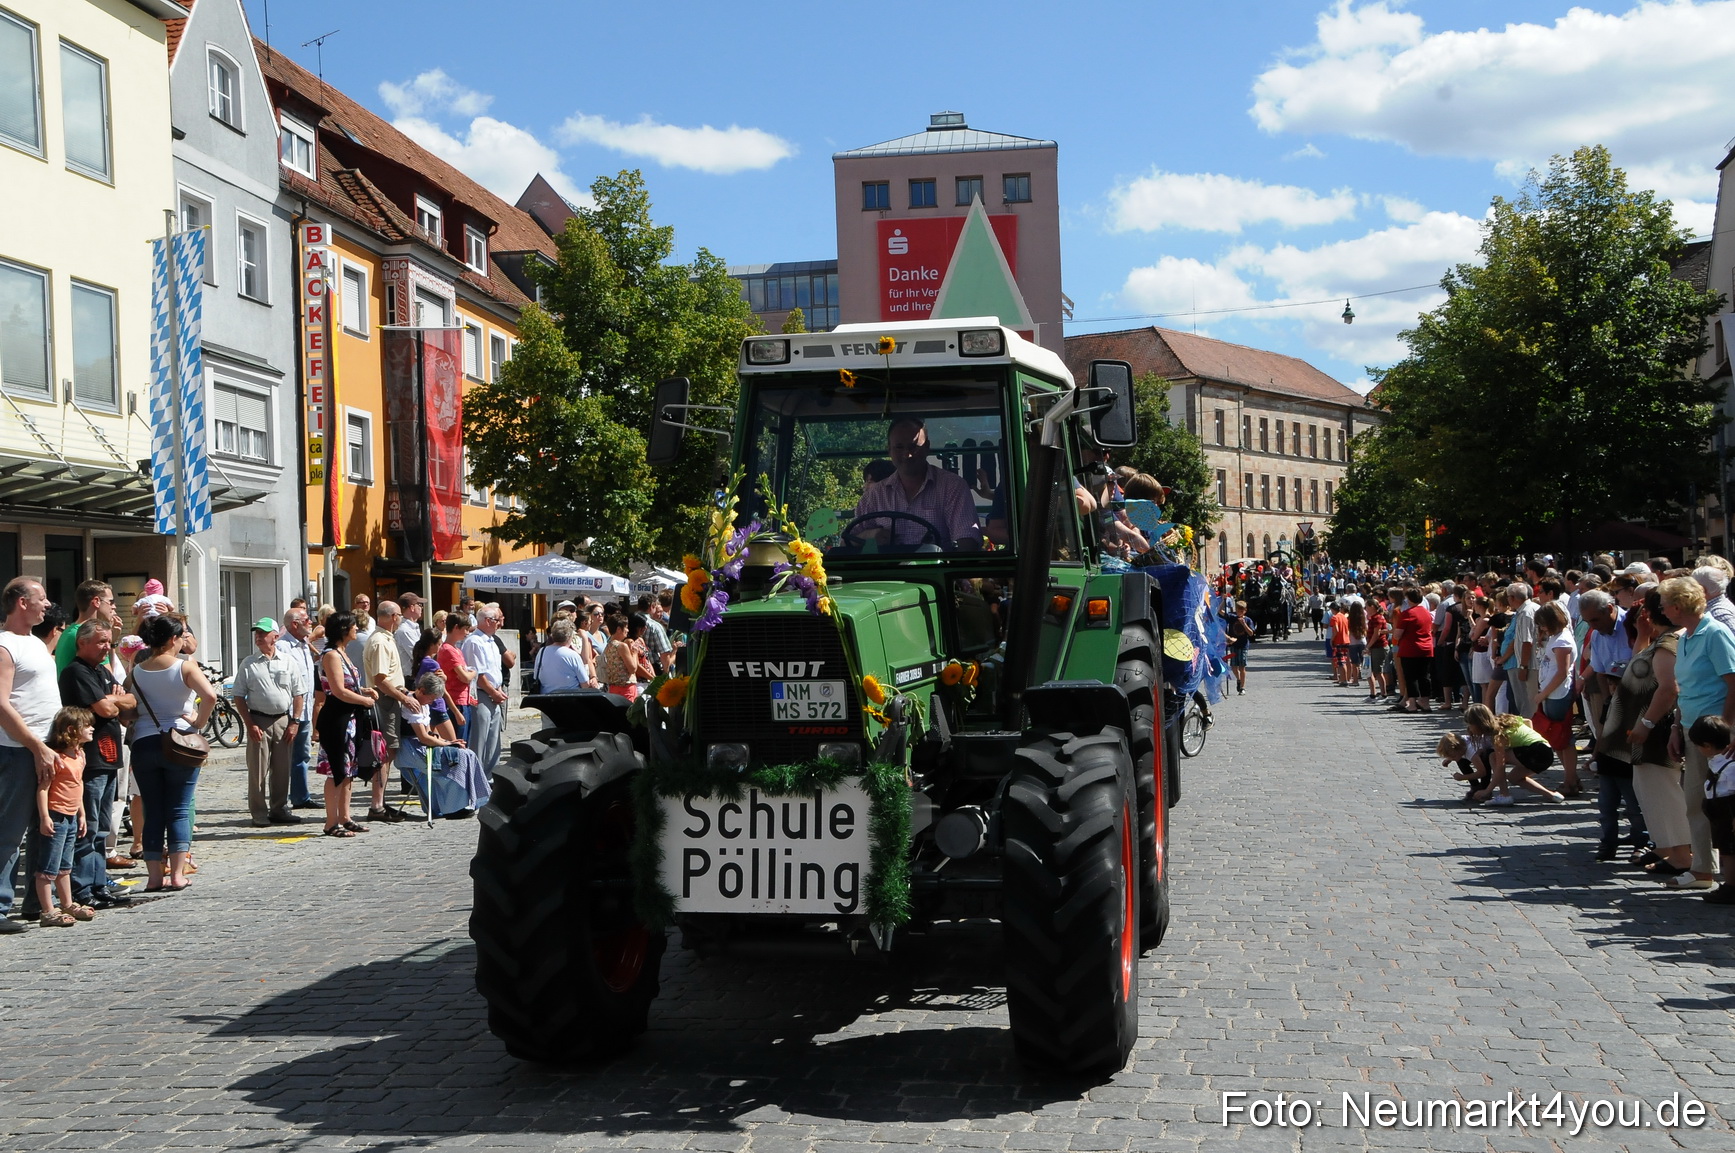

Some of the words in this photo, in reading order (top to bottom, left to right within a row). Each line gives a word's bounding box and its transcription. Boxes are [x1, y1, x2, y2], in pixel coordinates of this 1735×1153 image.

[889, 266, 939, 281] Danke
[889, 288, 903, 298] für
[906, 288, 920, 298] Ihr
[889, 302, 909, 312] und
[912, 301, 932, 311] Ihre
[306, 226, 323, 429] BÄCKEREI
[840, 341, 907, 356] FENT
[309, 442, 322, 454] ca
[310, 468, 323, 481] pla
[474, 575, 502, 583] Winkler
[503, 575, 519, 584] Bräu
[548, 576, 576, 585] Winkler
[577, 577, 594, 586] Bräu
[728, 661, 825, 678] FENDT
[786, 684, 811, 700] NM
[776, 702, 800, 719] MS
[807, 702, 842, 719] 572
[787, 726, 849, 735] TURBO
[683, 788, 855, 840] Schule
[683, 848, 860, 914] Pölling
